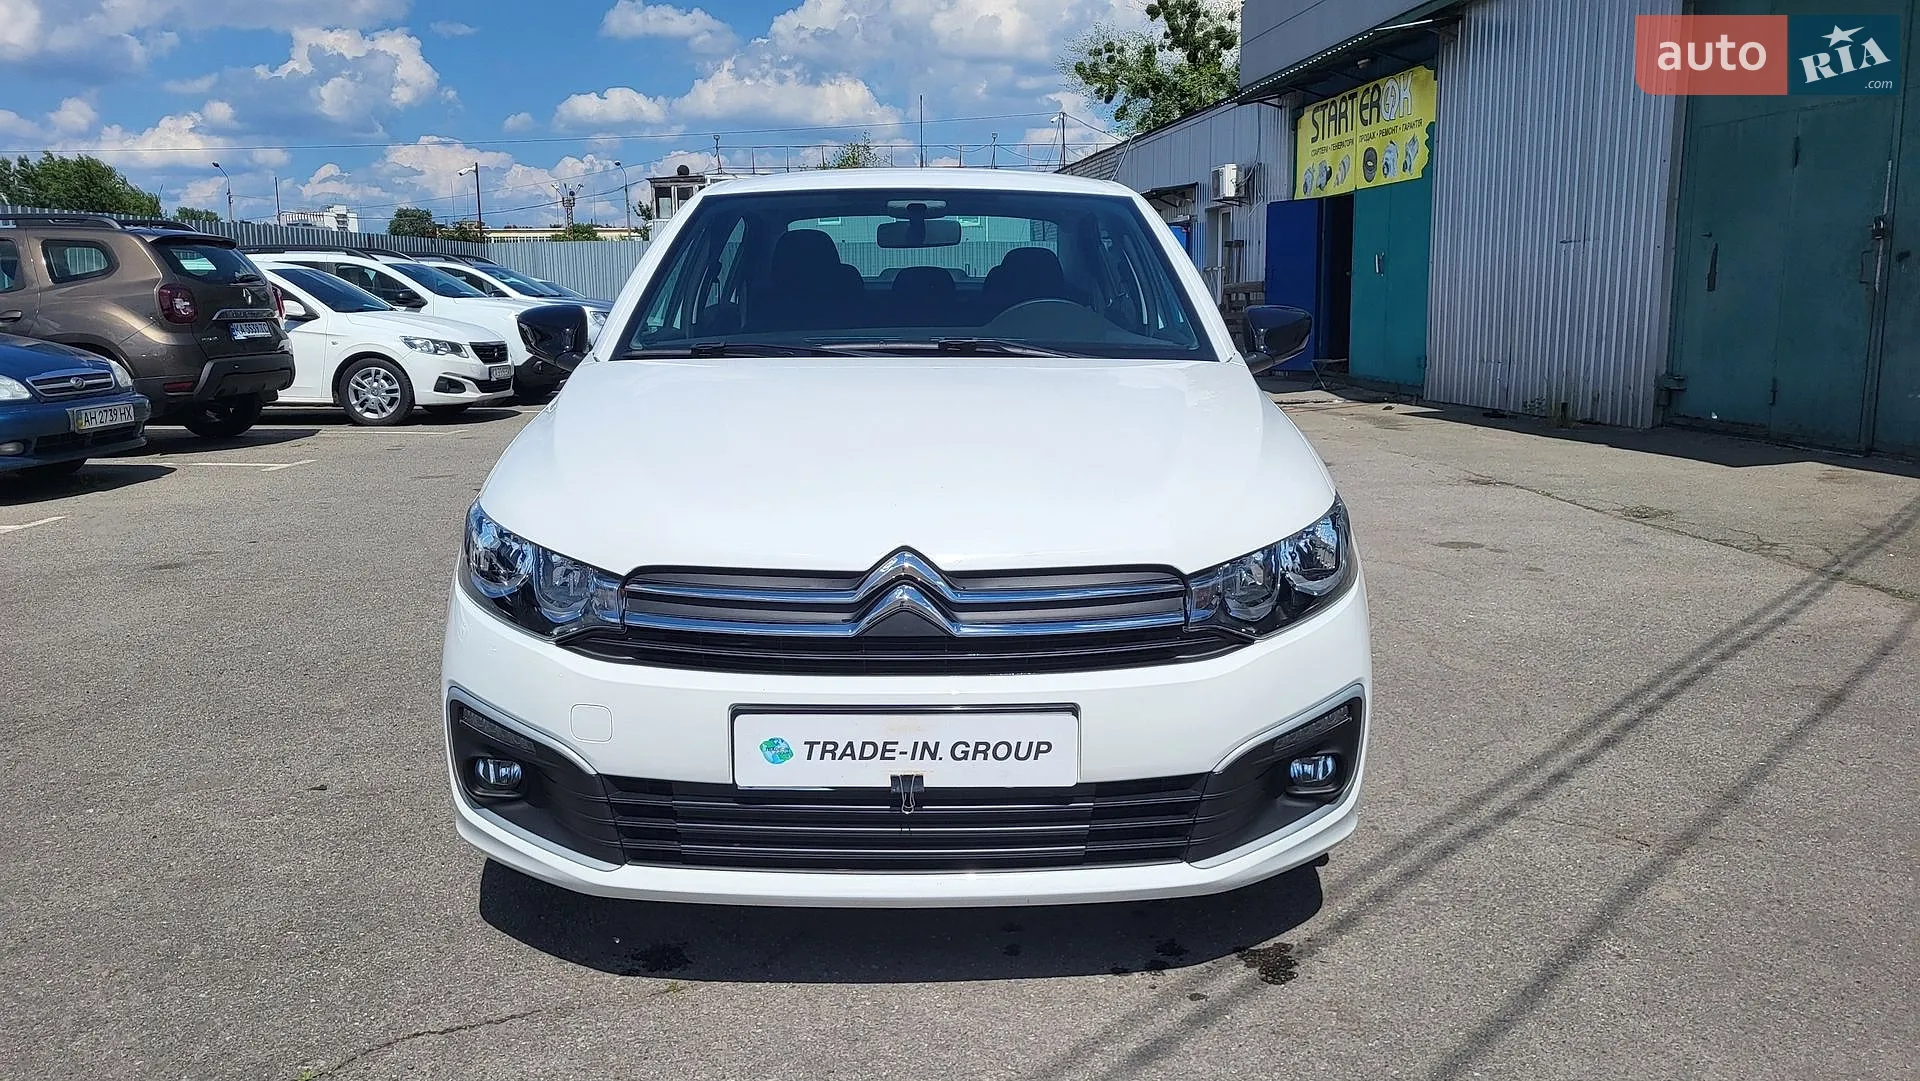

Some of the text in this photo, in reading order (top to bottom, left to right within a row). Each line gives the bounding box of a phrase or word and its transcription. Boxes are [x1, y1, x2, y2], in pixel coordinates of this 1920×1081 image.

[1379, 126, 1399, 137] РЕМОНТ
[84, 405, 133, 426] AH 2739 HX
[949, 740, 1053, 761] GROUP
